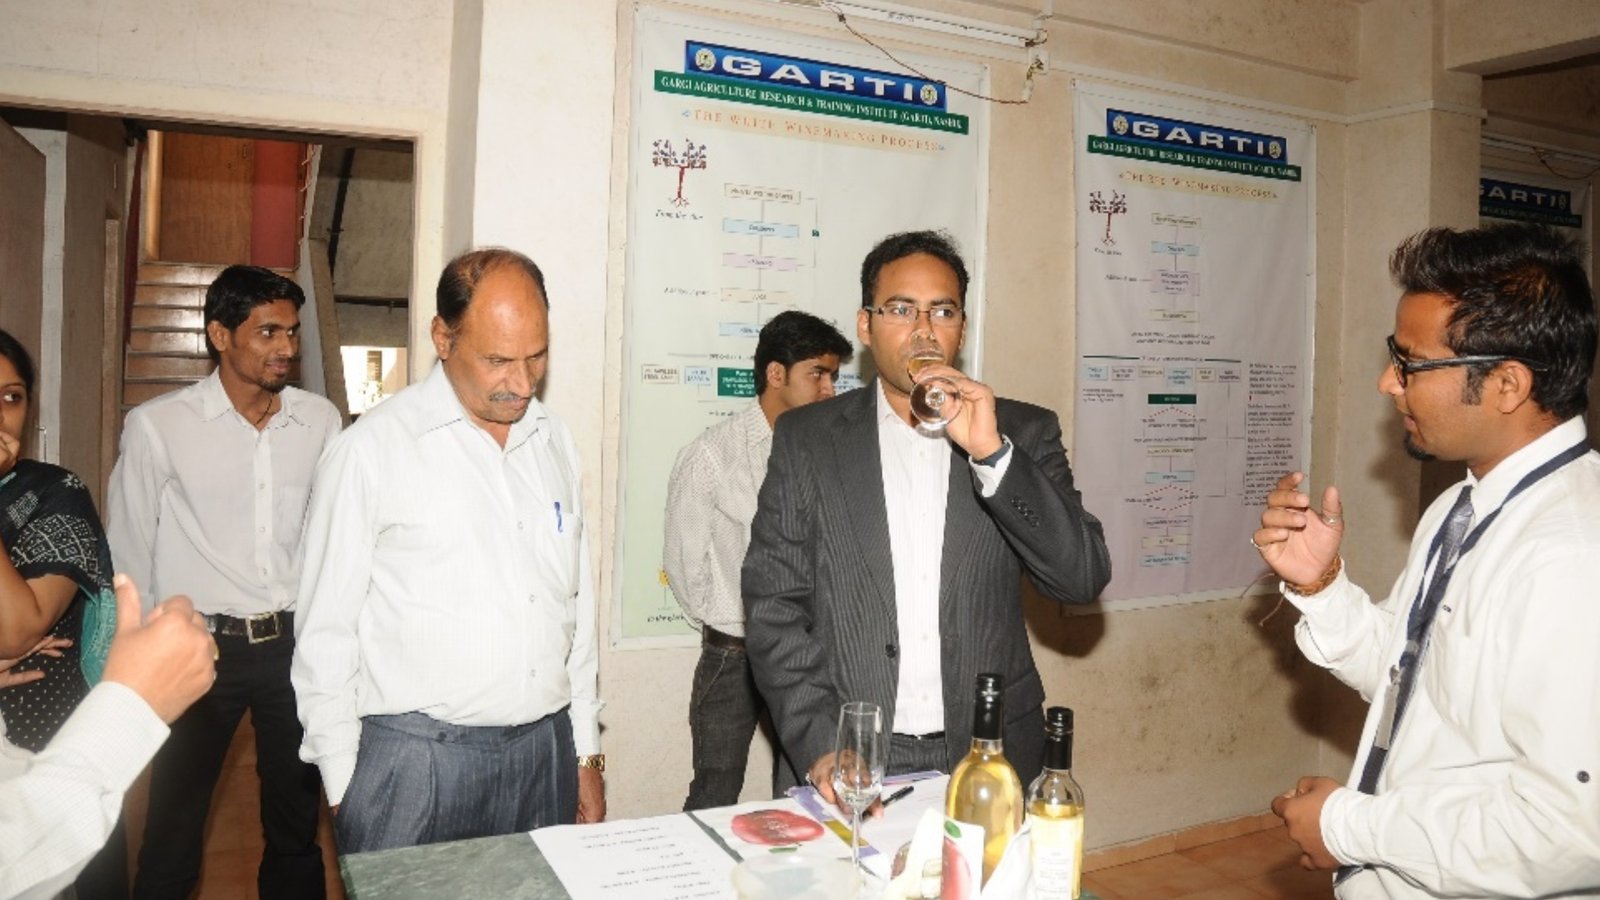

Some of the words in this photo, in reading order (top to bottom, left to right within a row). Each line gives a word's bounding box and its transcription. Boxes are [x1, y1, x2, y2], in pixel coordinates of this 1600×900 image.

[661, 76, 692, 90] GARGI
[694, 81, 757, 99] AGRICULTURE
[760, 90, 805, 106] RESEARCH
[816, 98, 855, 114] TRAINING
[721, 54, 914, 101] GARTI
[1132, 121, 1264, 155] GARTI
[1480, 184, 1556, 207] ARTI
